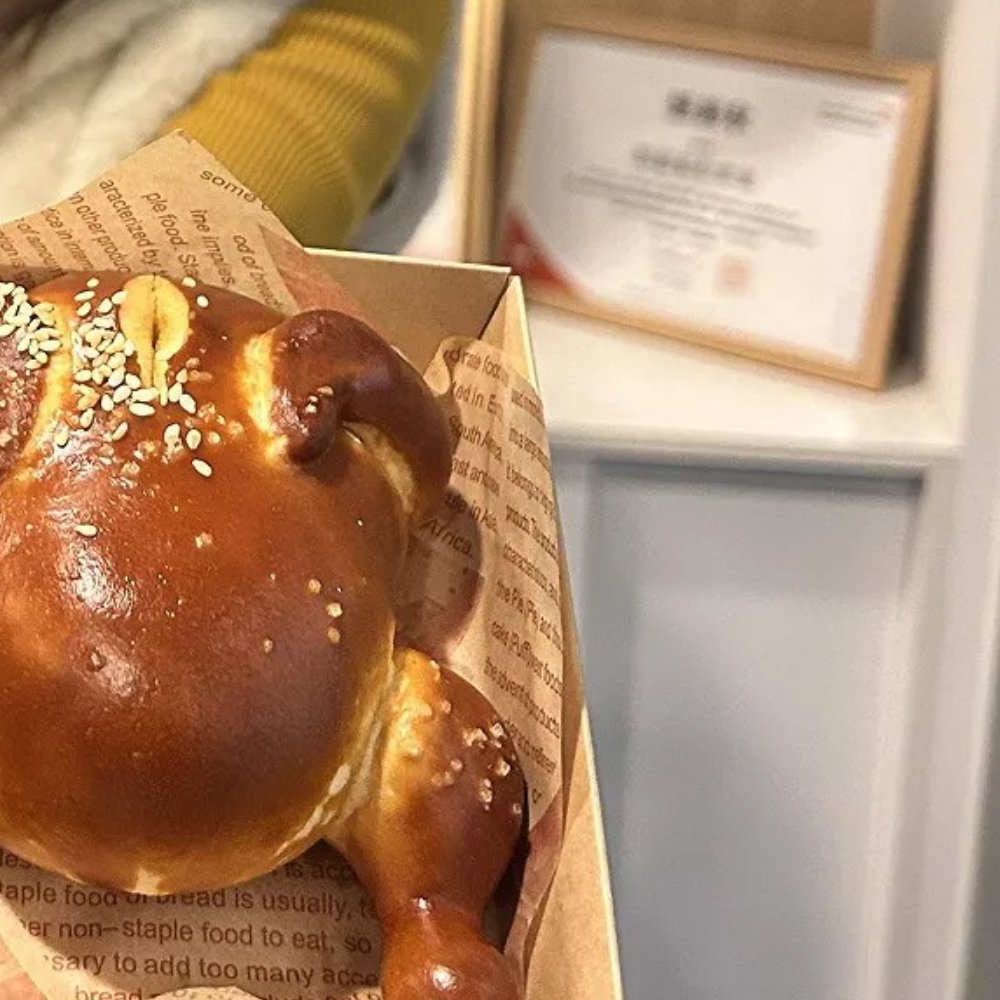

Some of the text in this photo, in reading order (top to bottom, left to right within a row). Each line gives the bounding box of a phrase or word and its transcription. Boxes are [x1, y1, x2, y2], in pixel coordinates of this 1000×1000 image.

[200, 170, 256, 203] some
[140, 249, 161, 267] by
[65, 885, 118, 907] food
[235, 889, 254, 908] is
[262, 893, 352, 922] usually,
[201, 921, 253, 946] food
[262, 926, 284, 946] to
[292, 931, 336, 954] eat,
[344, 937, 372, 954] so
[44, 954, 106, 975] sary
[113, 952, 137, 973] to
[144, 955, 191, 977] add
[199, 957, 239, 979] too
[246, 965, 315, 989] many
